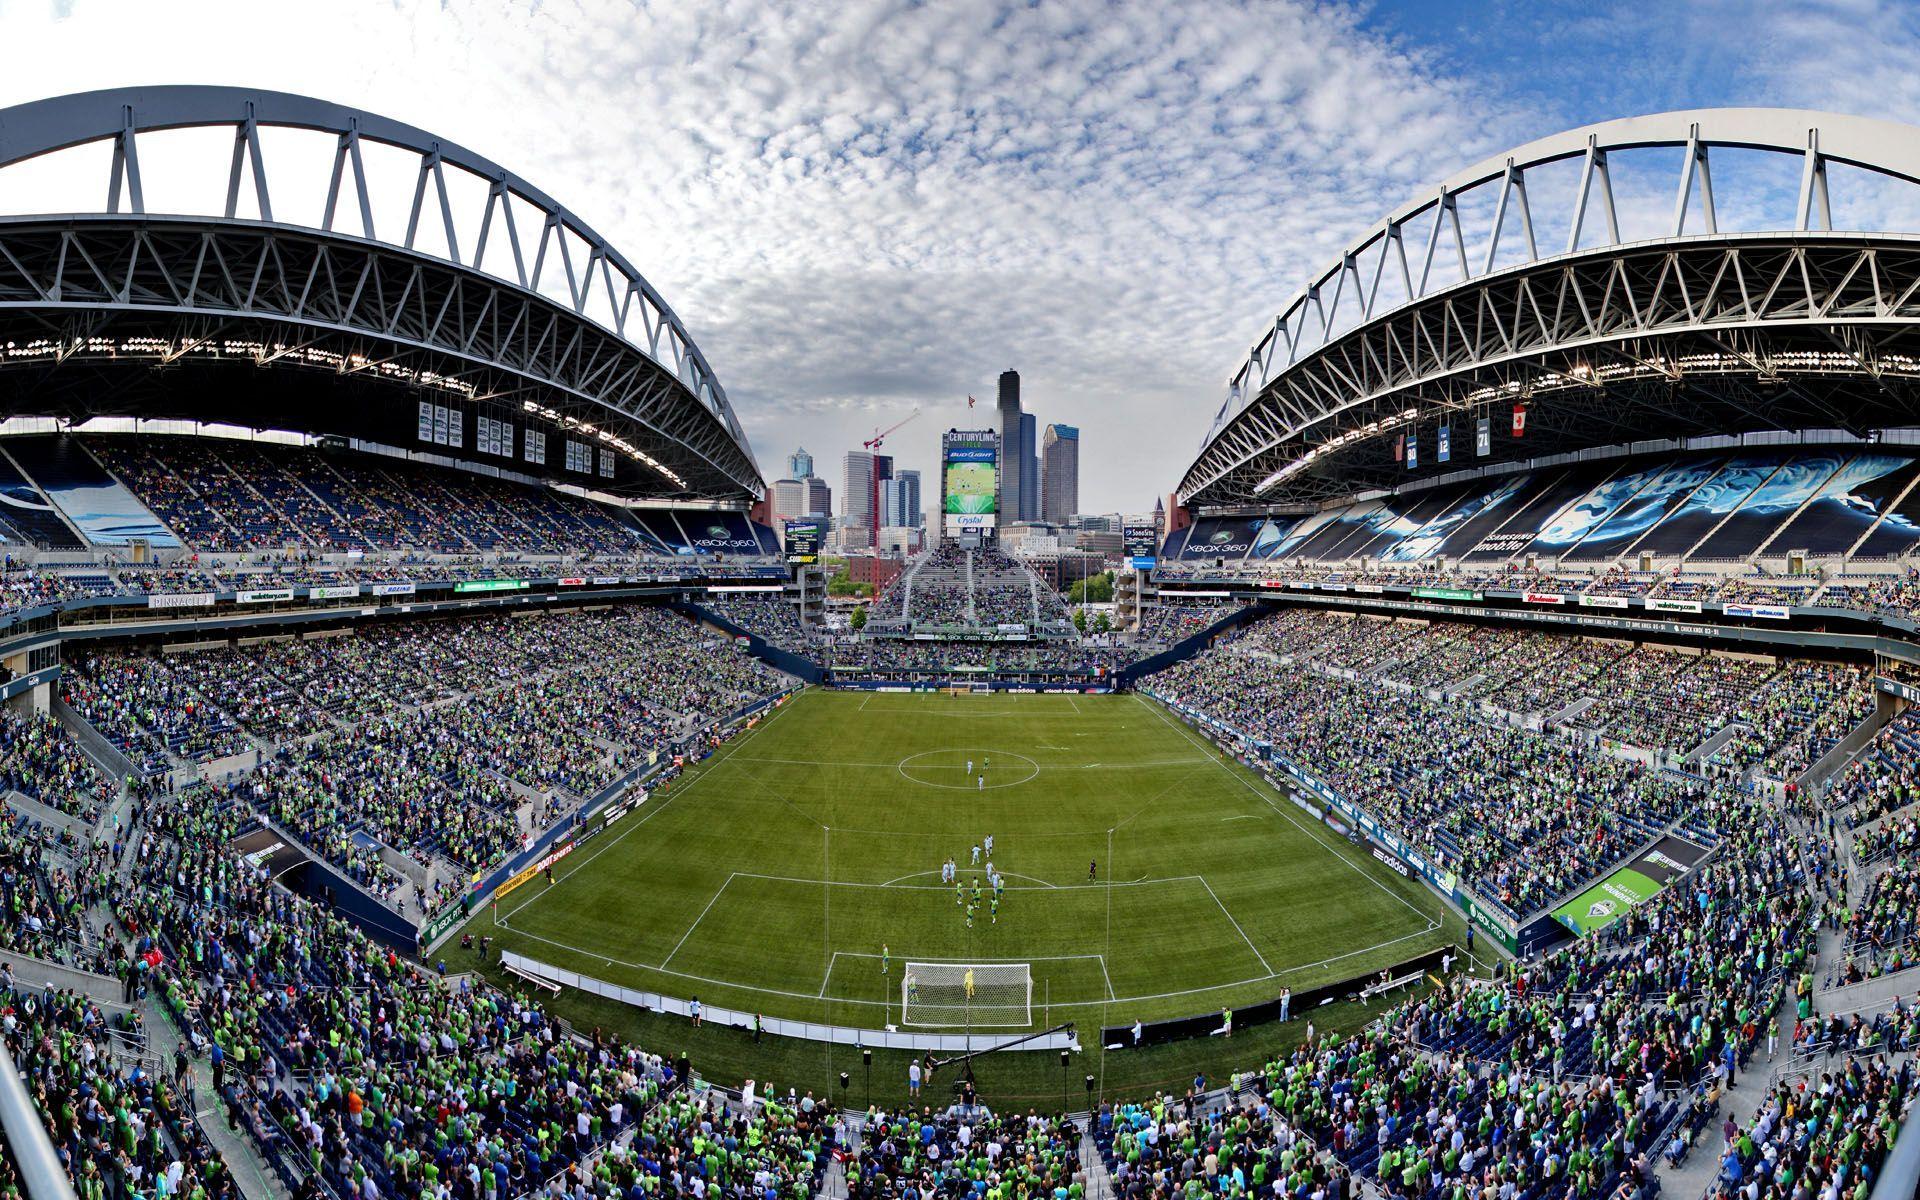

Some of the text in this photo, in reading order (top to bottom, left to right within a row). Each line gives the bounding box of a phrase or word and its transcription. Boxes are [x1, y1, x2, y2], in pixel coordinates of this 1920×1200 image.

[1440, 440, 1448, 453] 12
[1478, 434, 1488, 447] 71
[1407, 448, 1416, 460] 80
[958, 516, 983, 525] Crystal
[1528, 595, 1558, 603] Budweiser
[1658, 603, 1696, 611] walottery.com
[553, 845, 572, 862] SPORTS
[537, 855, 553, 872] ROOT
[1384, 855, 1408, 876] adidas
[495, 875, 523, 897] Continental
[1602, 883, 1633, 904] SOUNDERS
[1616, 883, 1641, 899] SEATTLE
[452, 905, 463, 919] PITC
[438, 914, 452, 932] XBOX
[1476, 910, 1506, 942] XBOX PITCH
